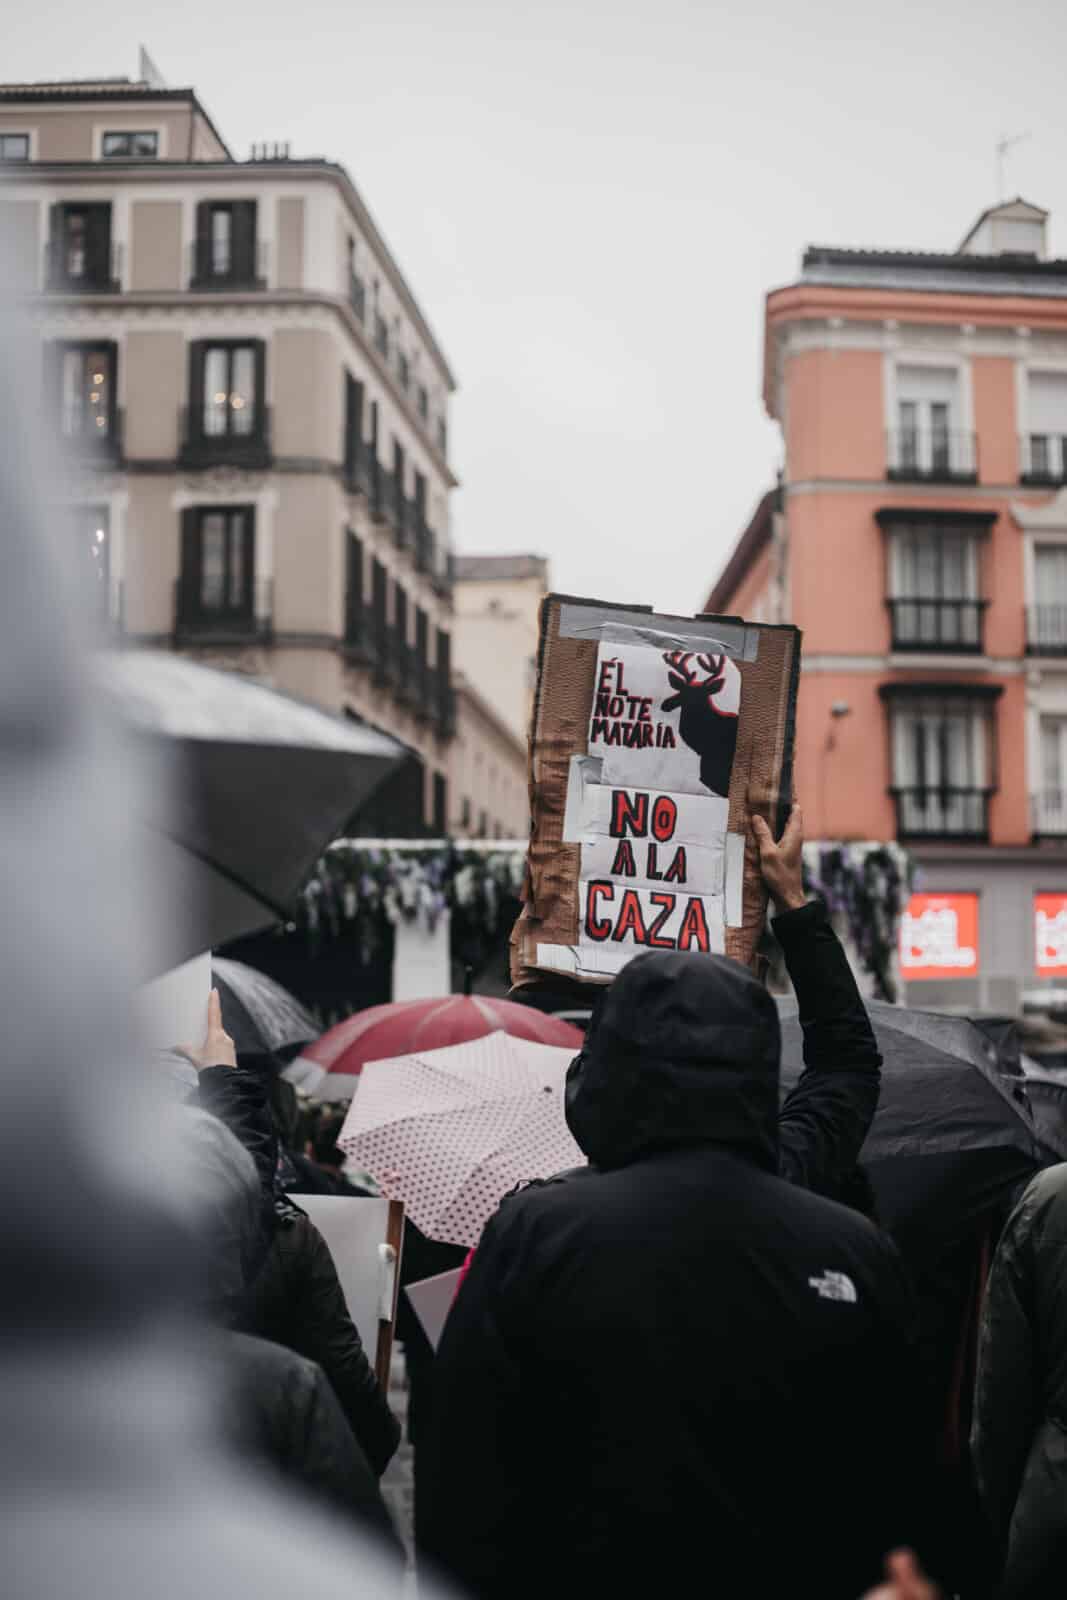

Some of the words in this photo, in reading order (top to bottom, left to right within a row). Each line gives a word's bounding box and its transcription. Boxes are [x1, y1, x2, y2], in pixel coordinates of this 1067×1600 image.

[599, 656, 628, 696] ÉL
[591, 718, 676, 749] MATARÍA
[609, 790, 677, 842] NO
[610, 839, 636, 877] A
[646, 843, 687, 883] LA
[585, 879, 711, 952] CAZA
